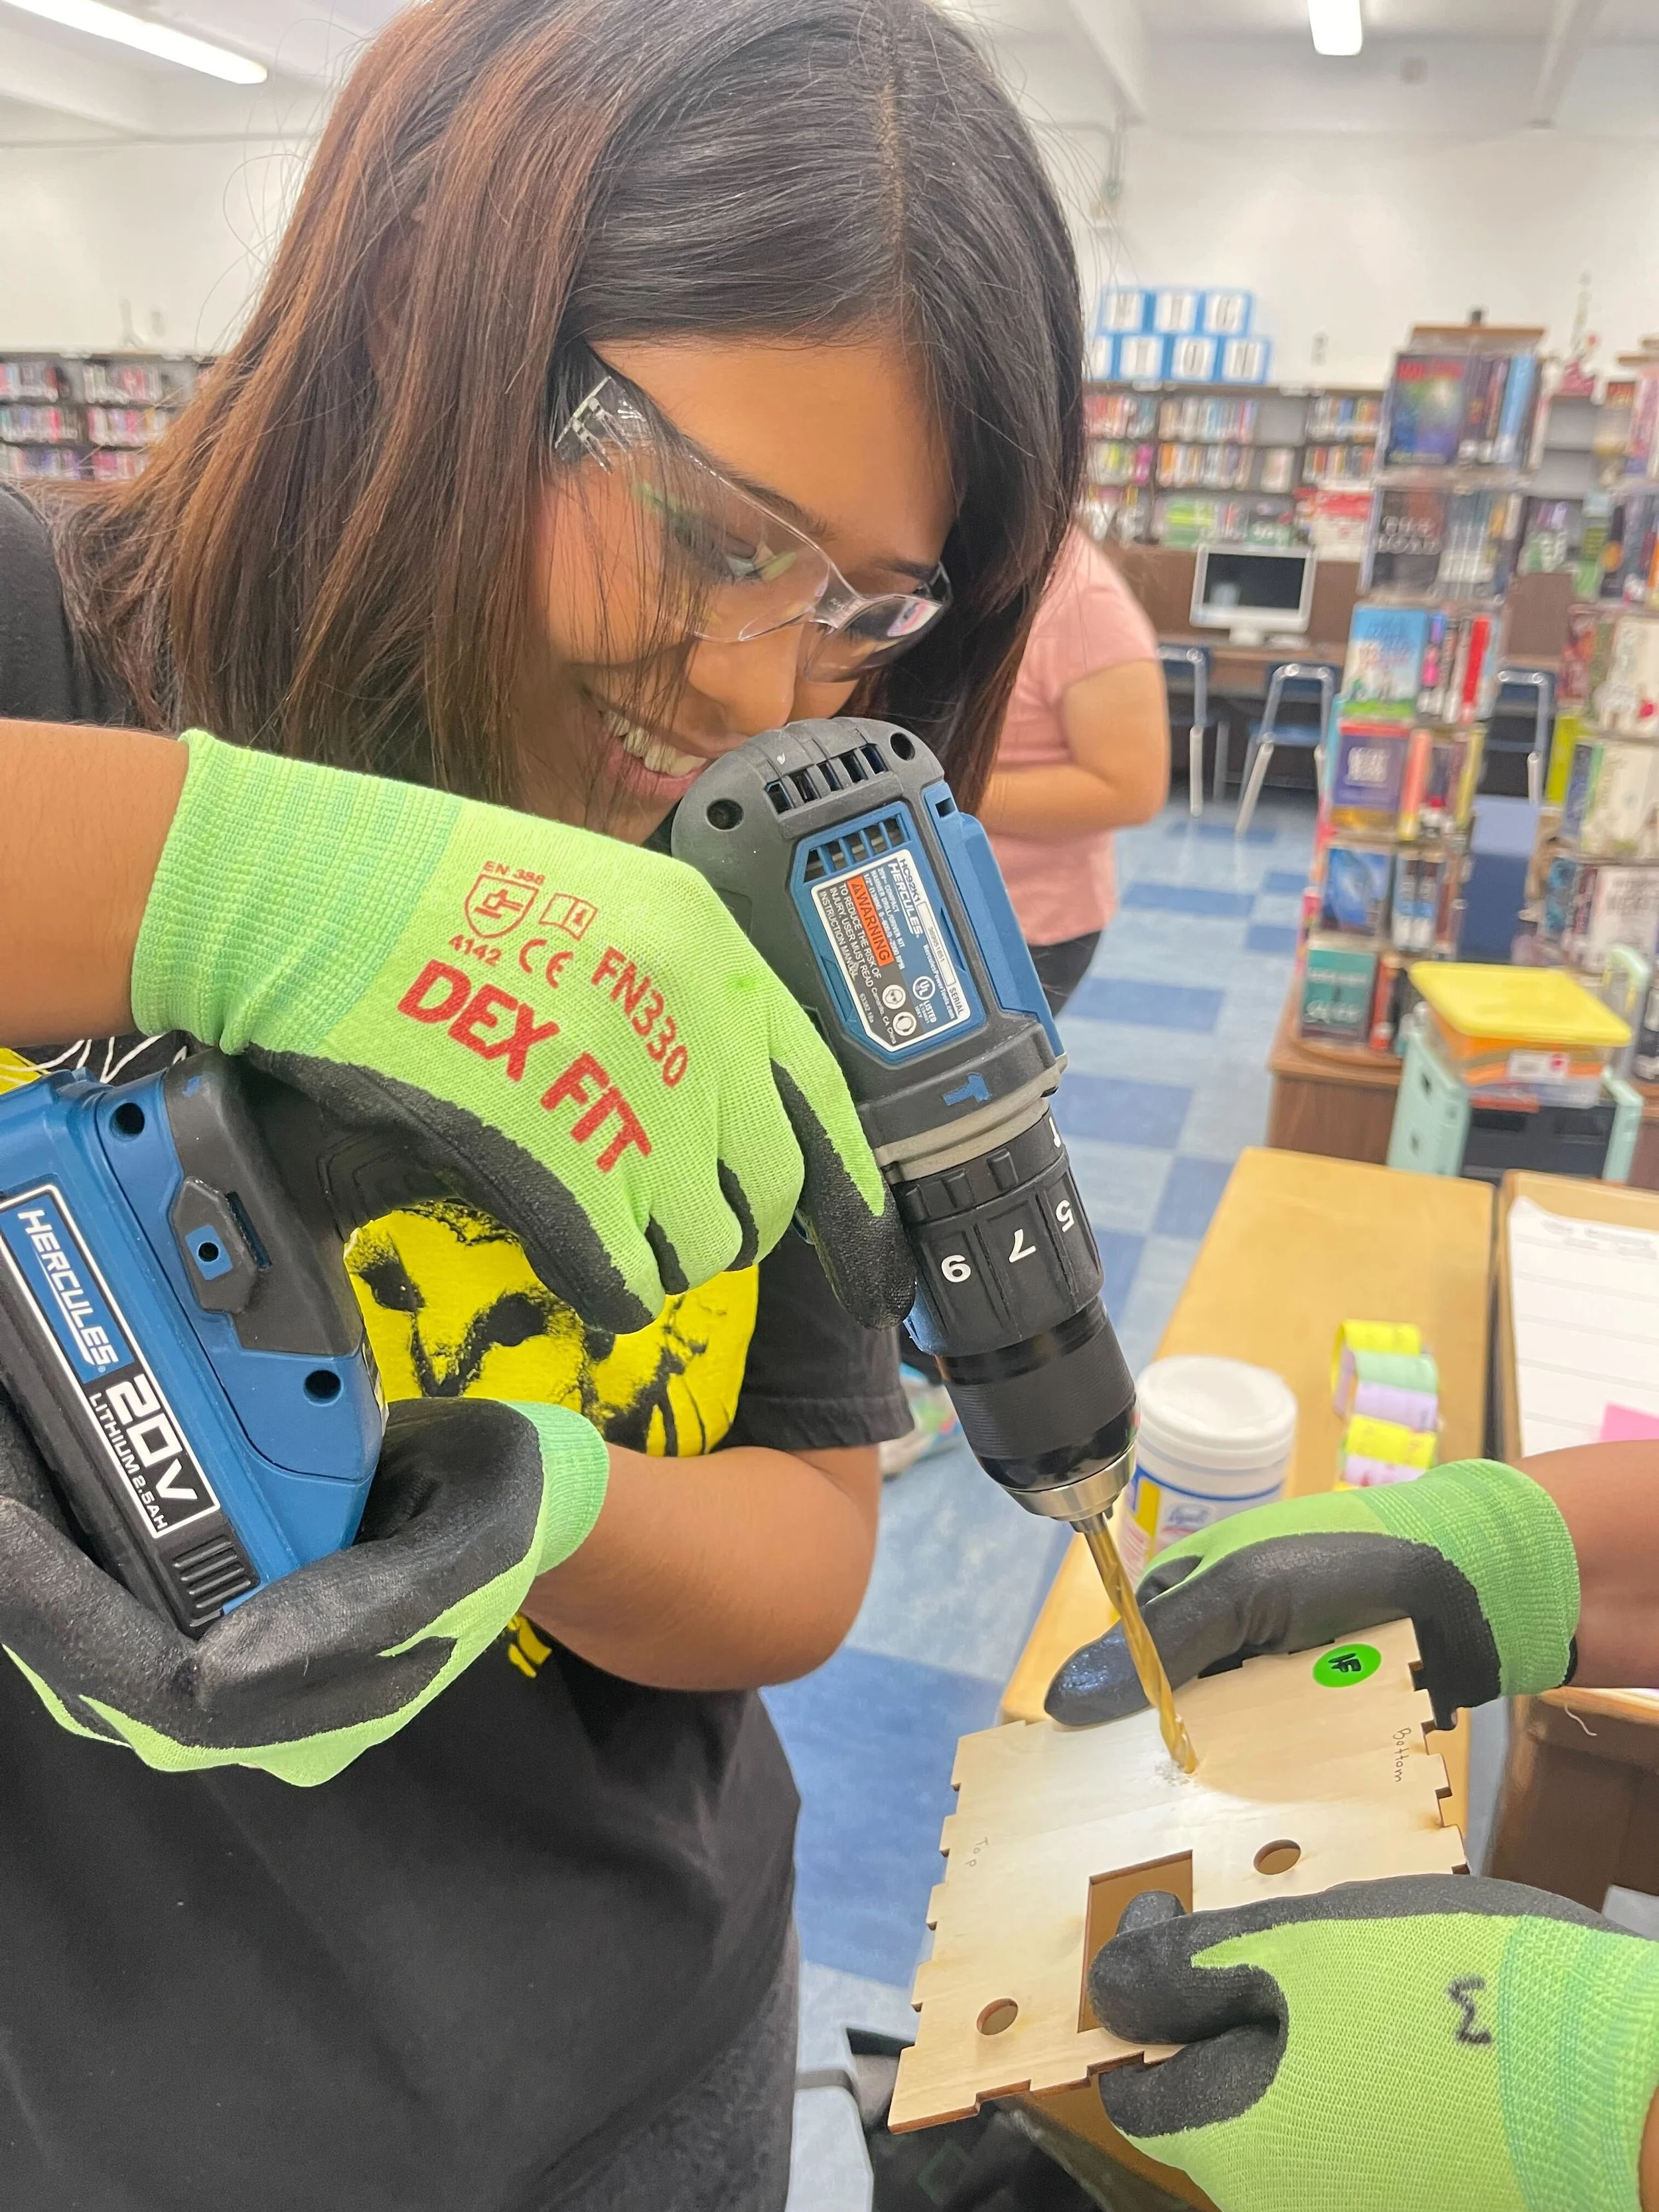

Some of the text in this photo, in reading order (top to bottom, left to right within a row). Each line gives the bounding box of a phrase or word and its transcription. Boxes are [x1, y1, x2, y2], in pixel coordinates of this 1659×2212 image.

[483, 860, 510, 875] EN
[899, 858, 921, 903] HC92K1
[819, 891, 845, 945] INSTRUCTION
[855, 891, 891, 961] WARNING
[870, 869, 885, 897] HAMMER
[896, 937, 905, 948] KIT
[883, 884, 899, 913] COMPACT
[887, 861, 924, 936] HERCULES
[448, 934, 502, 967] 4142
[837, 883, 881, 980] TO REDUCE THE RISK OF
[841, 917, 855, 941] USER
[849, 941, 865, 964] MUST
[859, 964, 874, 988] READ
[895, 955, 904, 970] RPM
[922, 944, 956, 1019] HerculesPowerTools.com
[591, 946, 689, 1088] FN330
[922, 999, 937, 1023] LISTED
[948, 987, 964, 1015] SERIAL
[882, 1015, 889, 1026] CA
[886, 1027, 897, 1044] China
[397, 958, 652, 1173] DEX FIT
[1055, 1199, 1074, 1232] 5
[1008, 1228, 1036, 1264] 7
[19, 1209, 119, 1367] HERCULES
[89, 1393, 169, 1530] LITHIUM 2.5AH
[105, 1372, 198, 1501] 20V
[1392, 1727, 1411, 1783] Bottom
